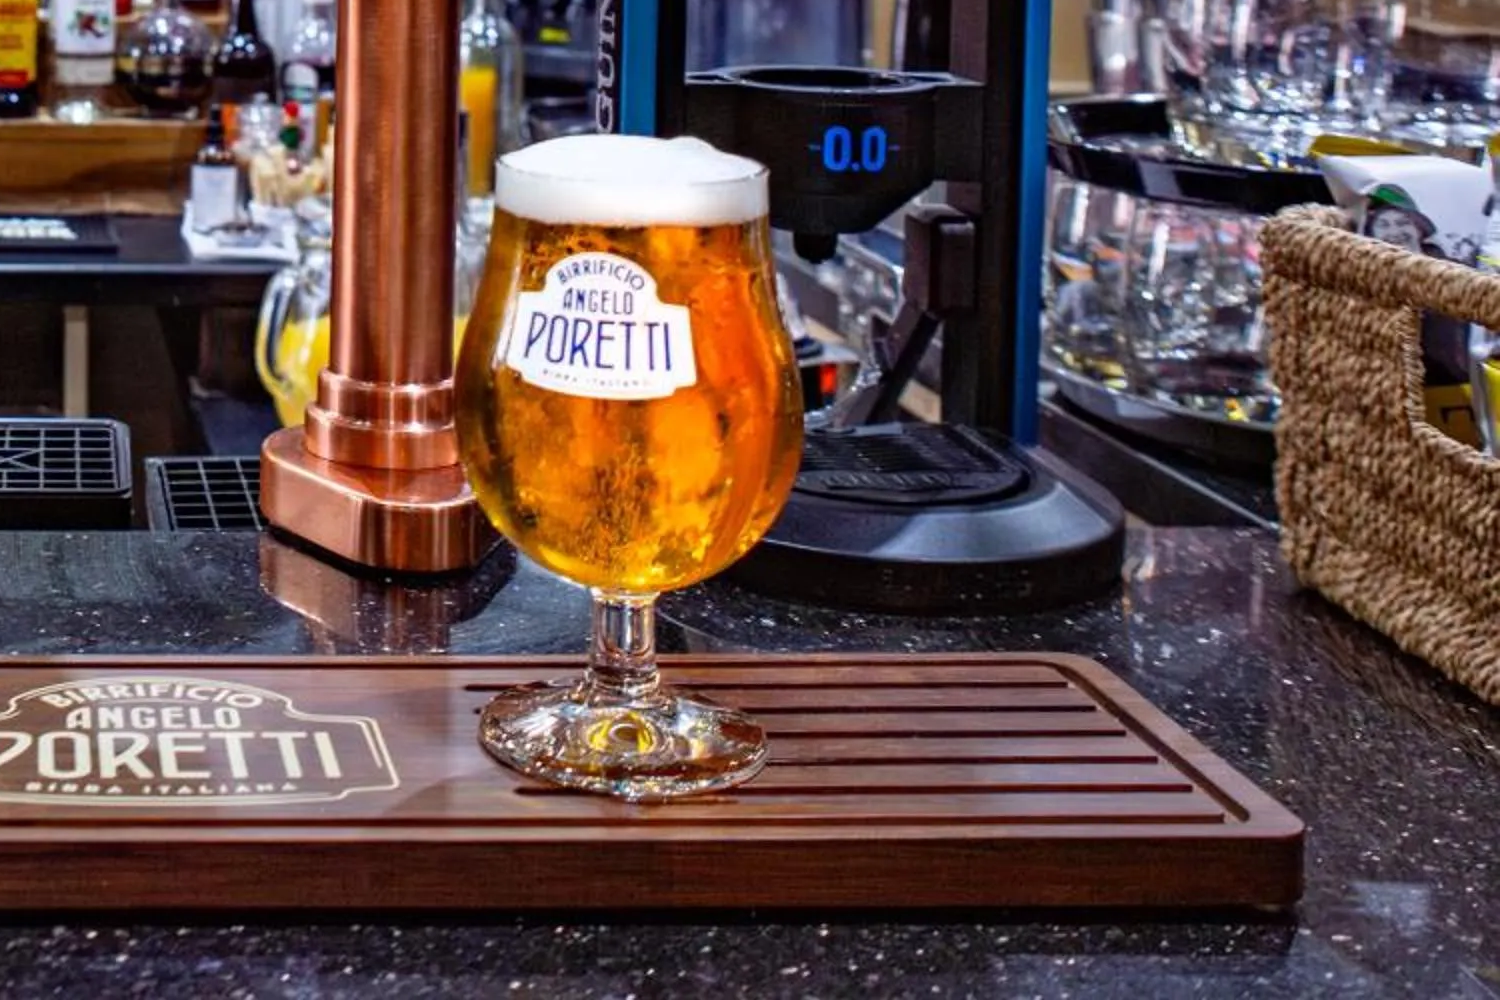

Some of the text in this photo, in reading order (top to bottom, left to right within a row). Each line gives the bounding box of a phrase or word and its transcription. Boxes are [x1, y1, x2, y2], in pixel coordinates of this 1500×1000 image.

[823, 126, 887, 173] 0.0
[557, 259, 646, 291] BIRRIFICIO
[563, 287, 635, 316] ANGELO
[524, 311, 673, 372] PORETTI
[40, 682, 263, 709] BIRRIFICIO
[66, 706, 243, 730] ANGELO
